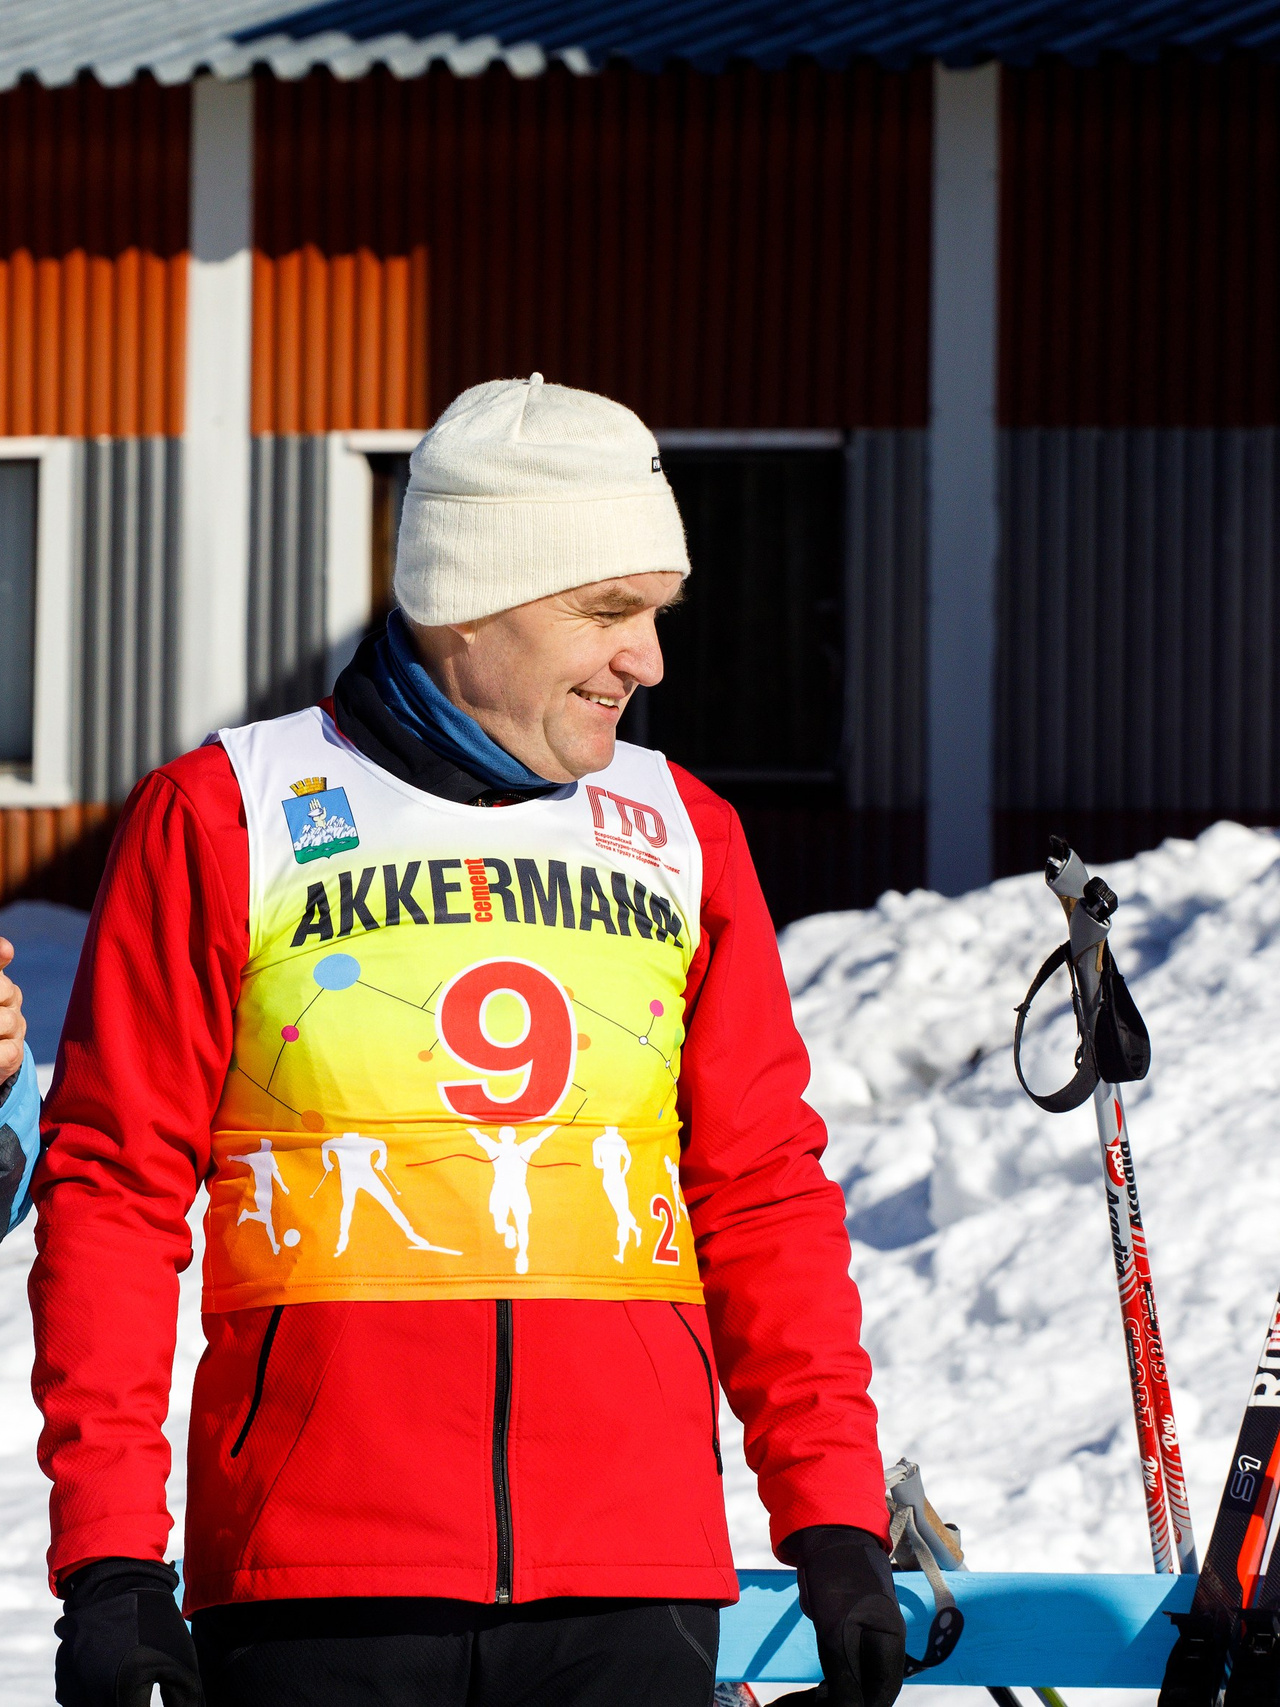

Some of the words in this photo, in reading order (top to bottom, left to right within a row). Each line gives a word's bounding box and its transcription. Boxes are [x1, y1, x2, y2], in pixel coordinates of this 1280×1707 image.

[585, 784, 668, 849] ГТО
[289, 857, 684, 949] AKKERMANN
[464, 858, 493, 922] cement
[434, 955, 578, 1124] 9
[650, 1194, 680, 1266] 2
